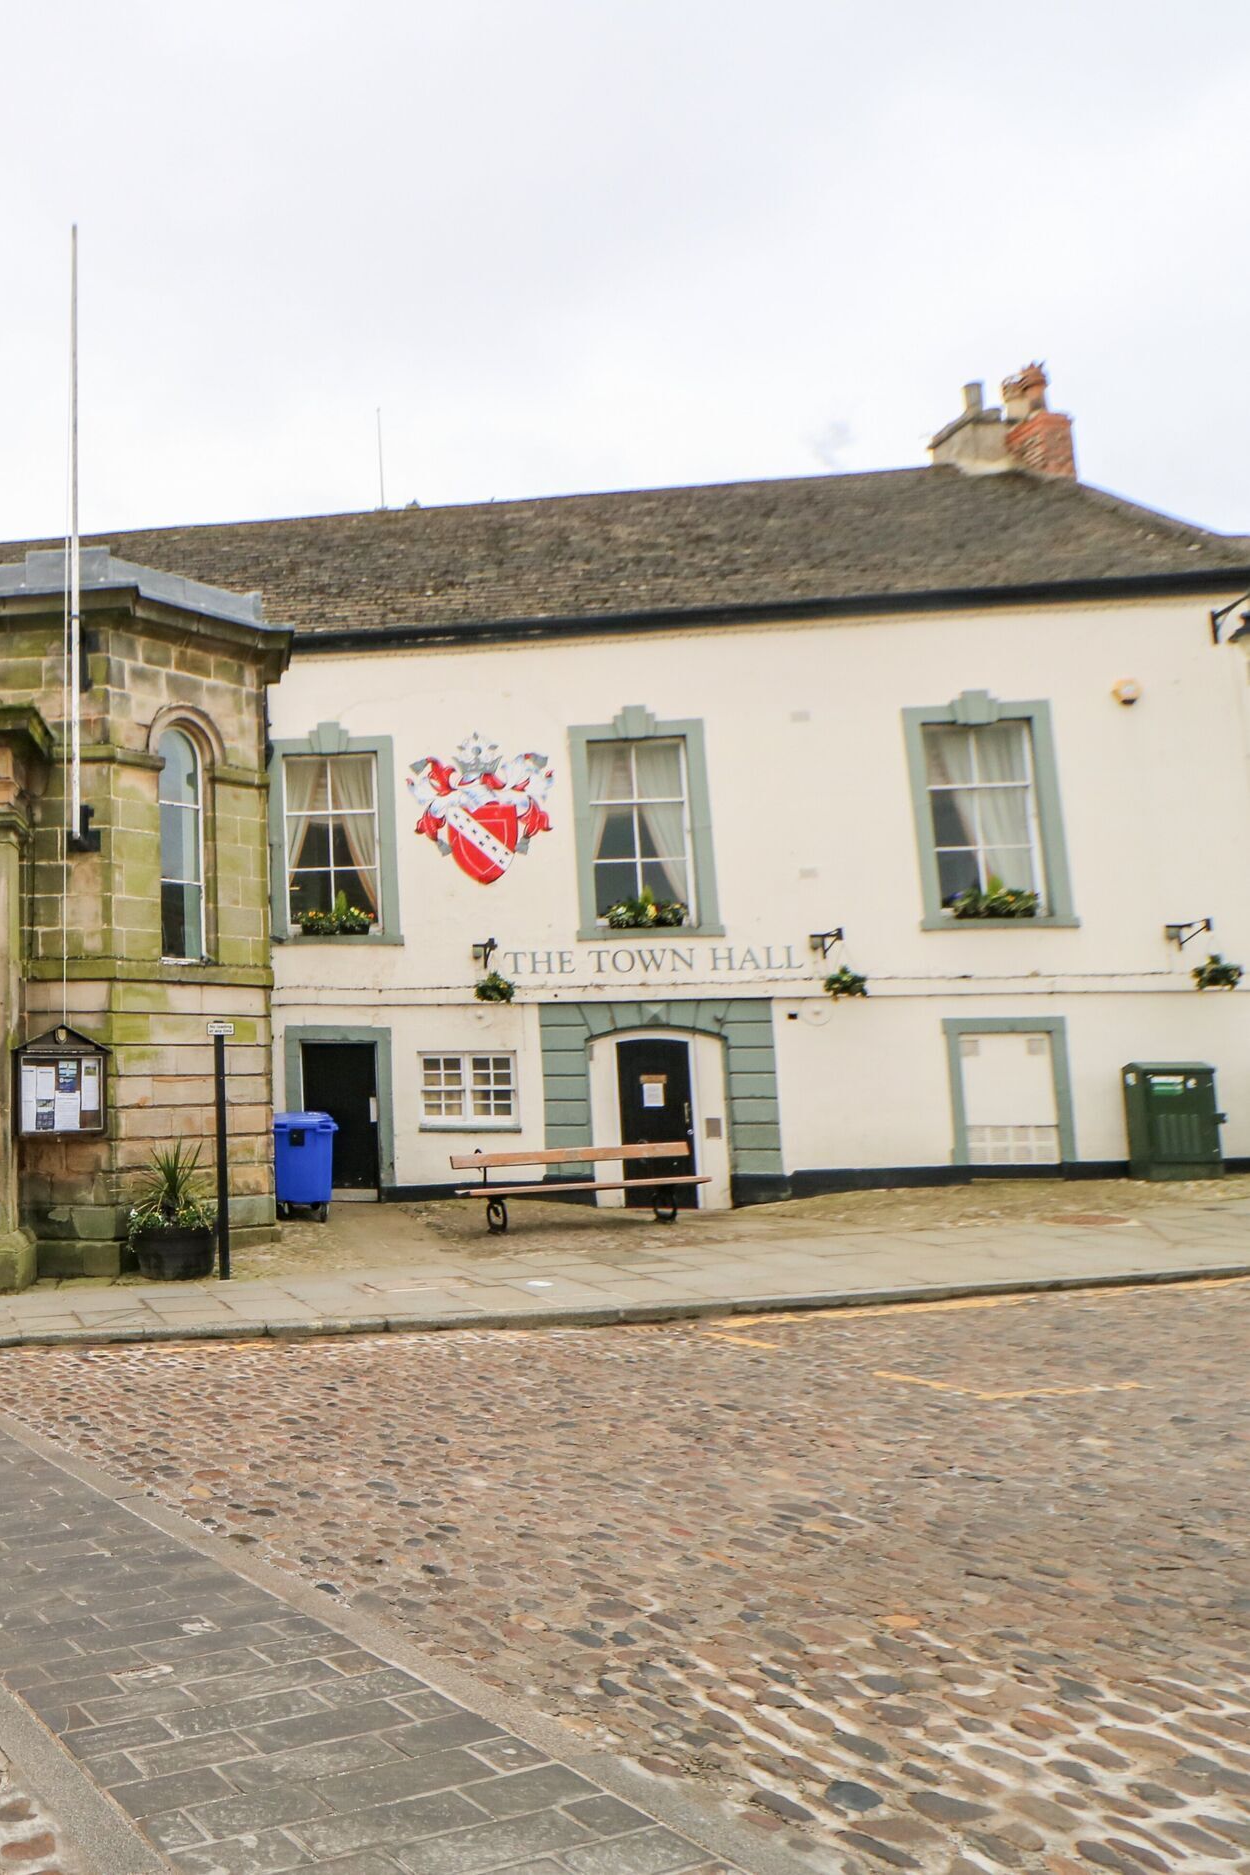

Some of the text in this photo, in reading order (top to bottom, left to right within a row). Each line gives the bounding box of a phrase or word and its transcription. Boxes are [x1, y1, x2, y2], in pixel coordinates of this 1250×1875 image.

[503, 945, 804, 975] THE TOWN HALL
